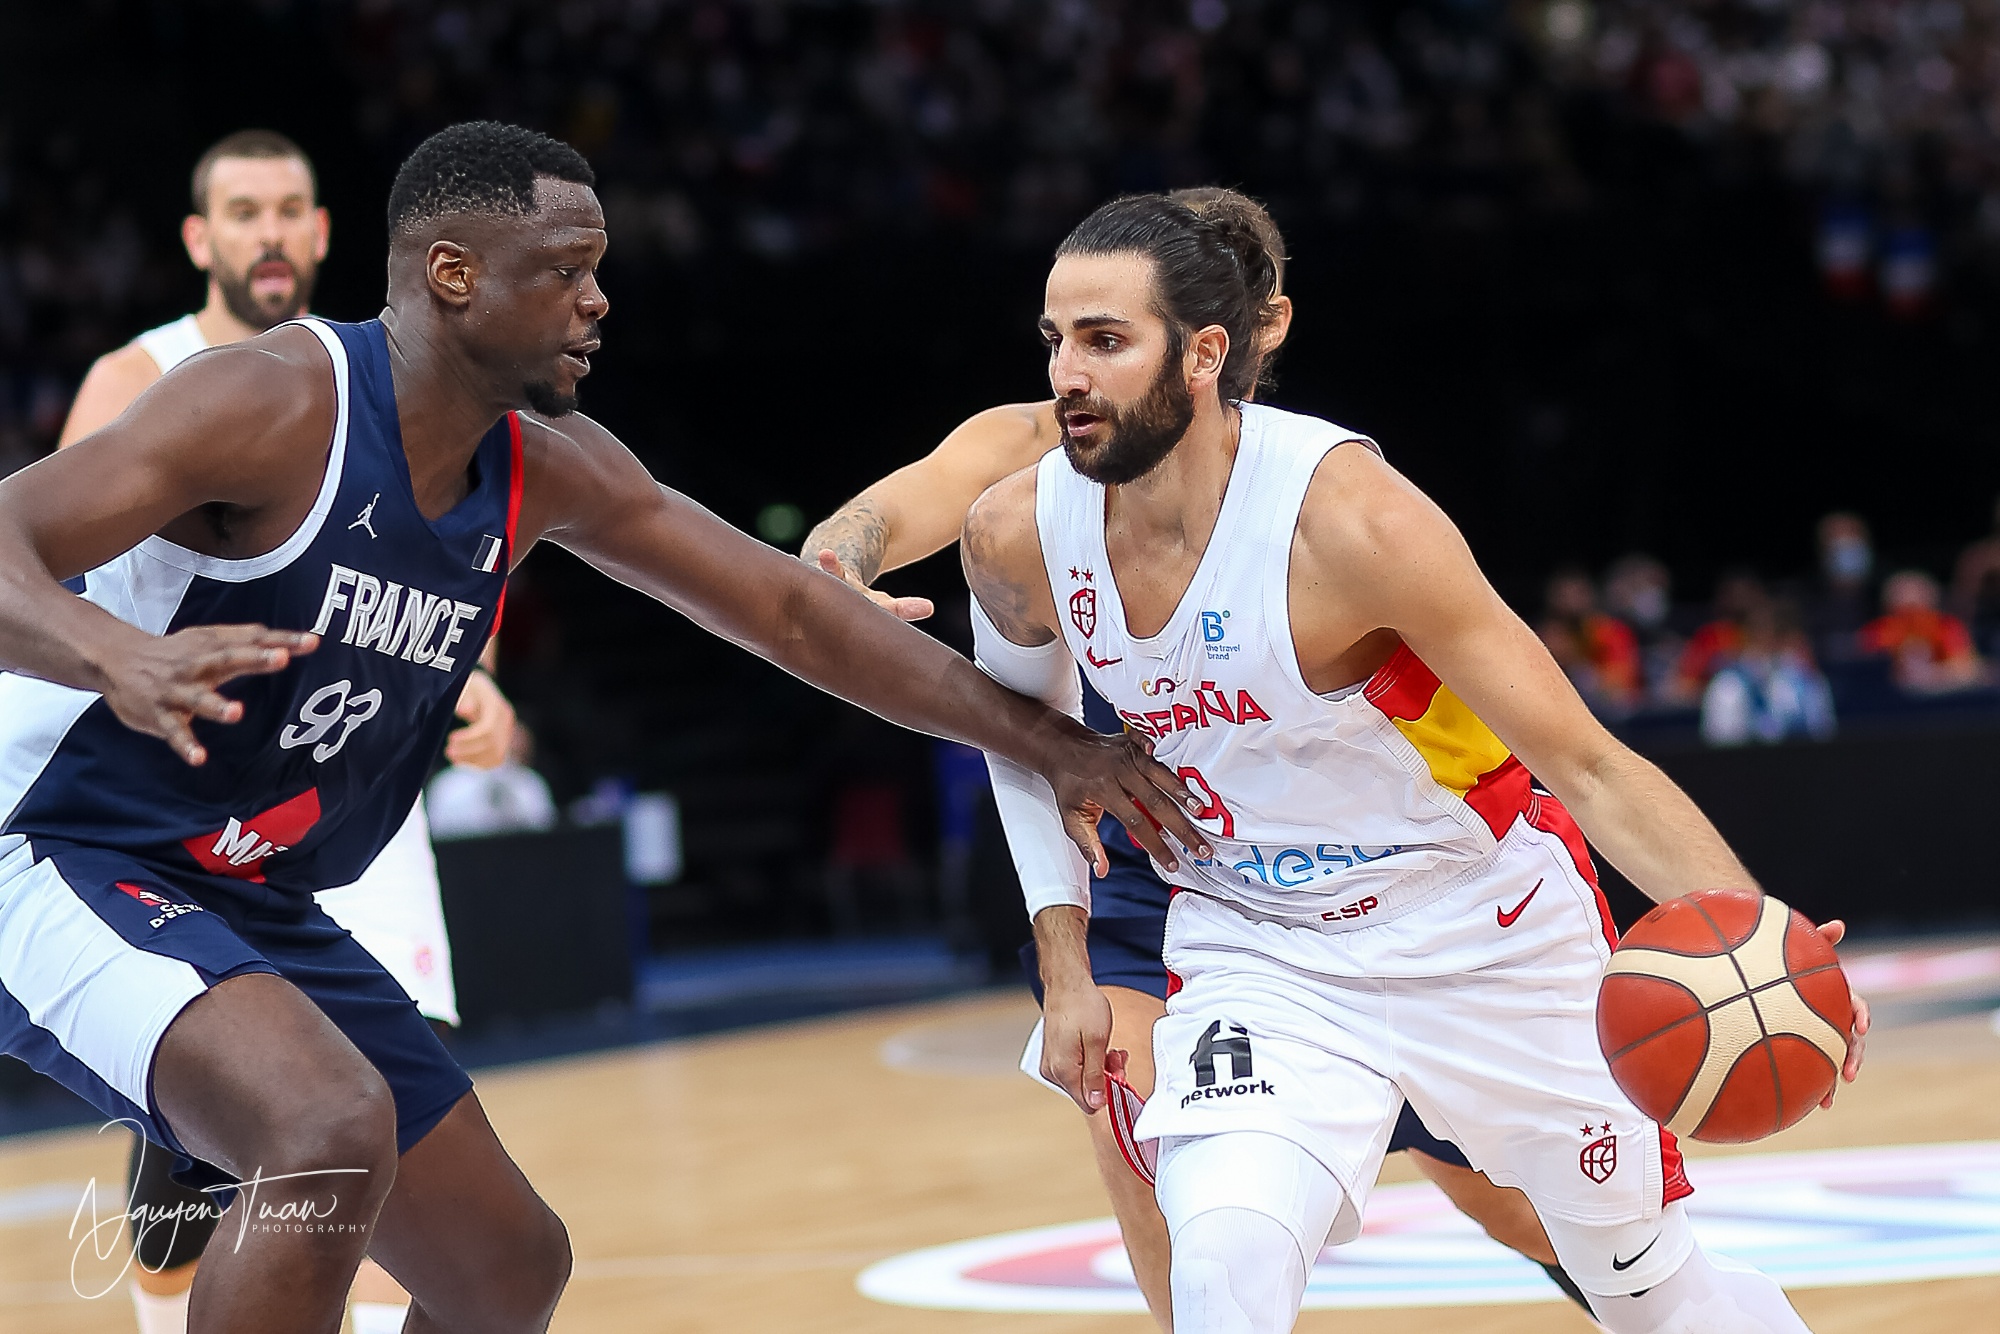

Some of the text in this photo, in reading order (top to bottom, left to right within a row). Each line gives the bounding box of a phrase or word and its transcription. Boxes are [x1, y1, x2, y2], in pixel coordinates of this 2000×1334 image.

[309, 563, 482, 672] FRANCE
[1205, 644, 1241, 652] the travel
[1207, 652, 1230, 660] brand
[279, 679, 383, 764] 93
[1119, 681, 1273, 738] SPAÑA
[211, 816, 288, 866] MA
[1320, 895, 1379, 922] ESP
[1180, 1080, 1276, 1110] network
